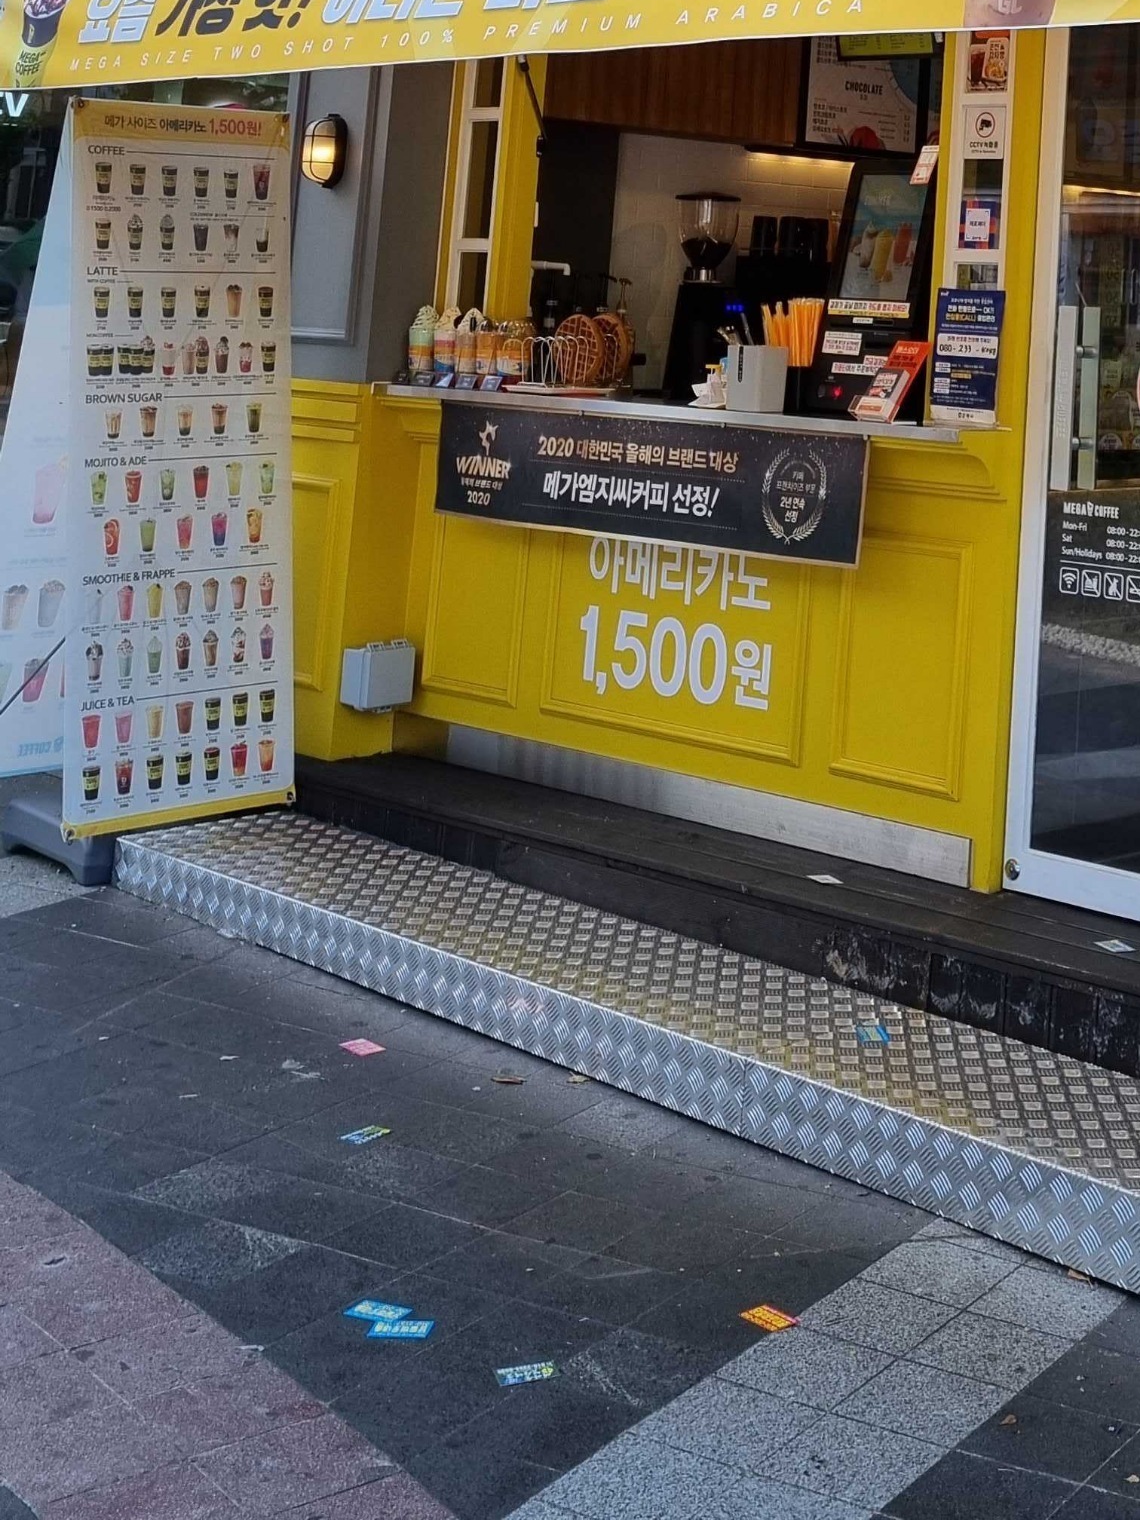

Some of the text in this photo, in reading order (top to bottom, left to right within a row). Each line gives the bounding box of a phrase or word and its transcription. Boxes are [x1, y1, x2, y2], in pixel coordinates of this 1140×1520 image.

[69, 54, 123, 72] MEGA
[140, 49, 194, 67] SIZE
[213, 43, 262, 60] TWO
[283, 36, 355, 57] SHOT
[380, 28, 456, 48] 100%
[483, 12, 643, 41] PREMIUM
[845, 80, 883, 95] CHOCOLATE
[104, 115, 262, 137] 메가 사이즈 아메리카노 1,500원!
[88, 145, 125, 157] COFFEE
[969, 141, 983, 149] CCTV
[87, 267, 118, 277] LATTE
[85, 392, 163, 404] BROWN SUGAR
[537, 434, 739, 474] 2020 대한민국 올해의 브랜드 대상
[84, 456, 147, 469] MOJITO & ADE
[456, 455, 511, 479] WINNER
[467, 490, 491, 506] 2020
[542, 470, 721, 518] 메가엠지씨커피 선정!
[780, 496, 806, 511] 2년 연속
[1063, 501, 1120, 520] MEGA COFFEE
[784, 510, 799, 523] 선정
[1062, 520, 1088, 532] Mon-Fri
[1062, 534, 1073, 543] Sat
[1061, 546, 1103, 561] Sun/Holidays
[82, 568, 176, 586] SMOOTHIE & FRAPPE
[588, 534, 771, 610] 아메리카노
[579, 605, 772, 711] 1,500원
[80, 696, 135, 712] JUICE & TEA
